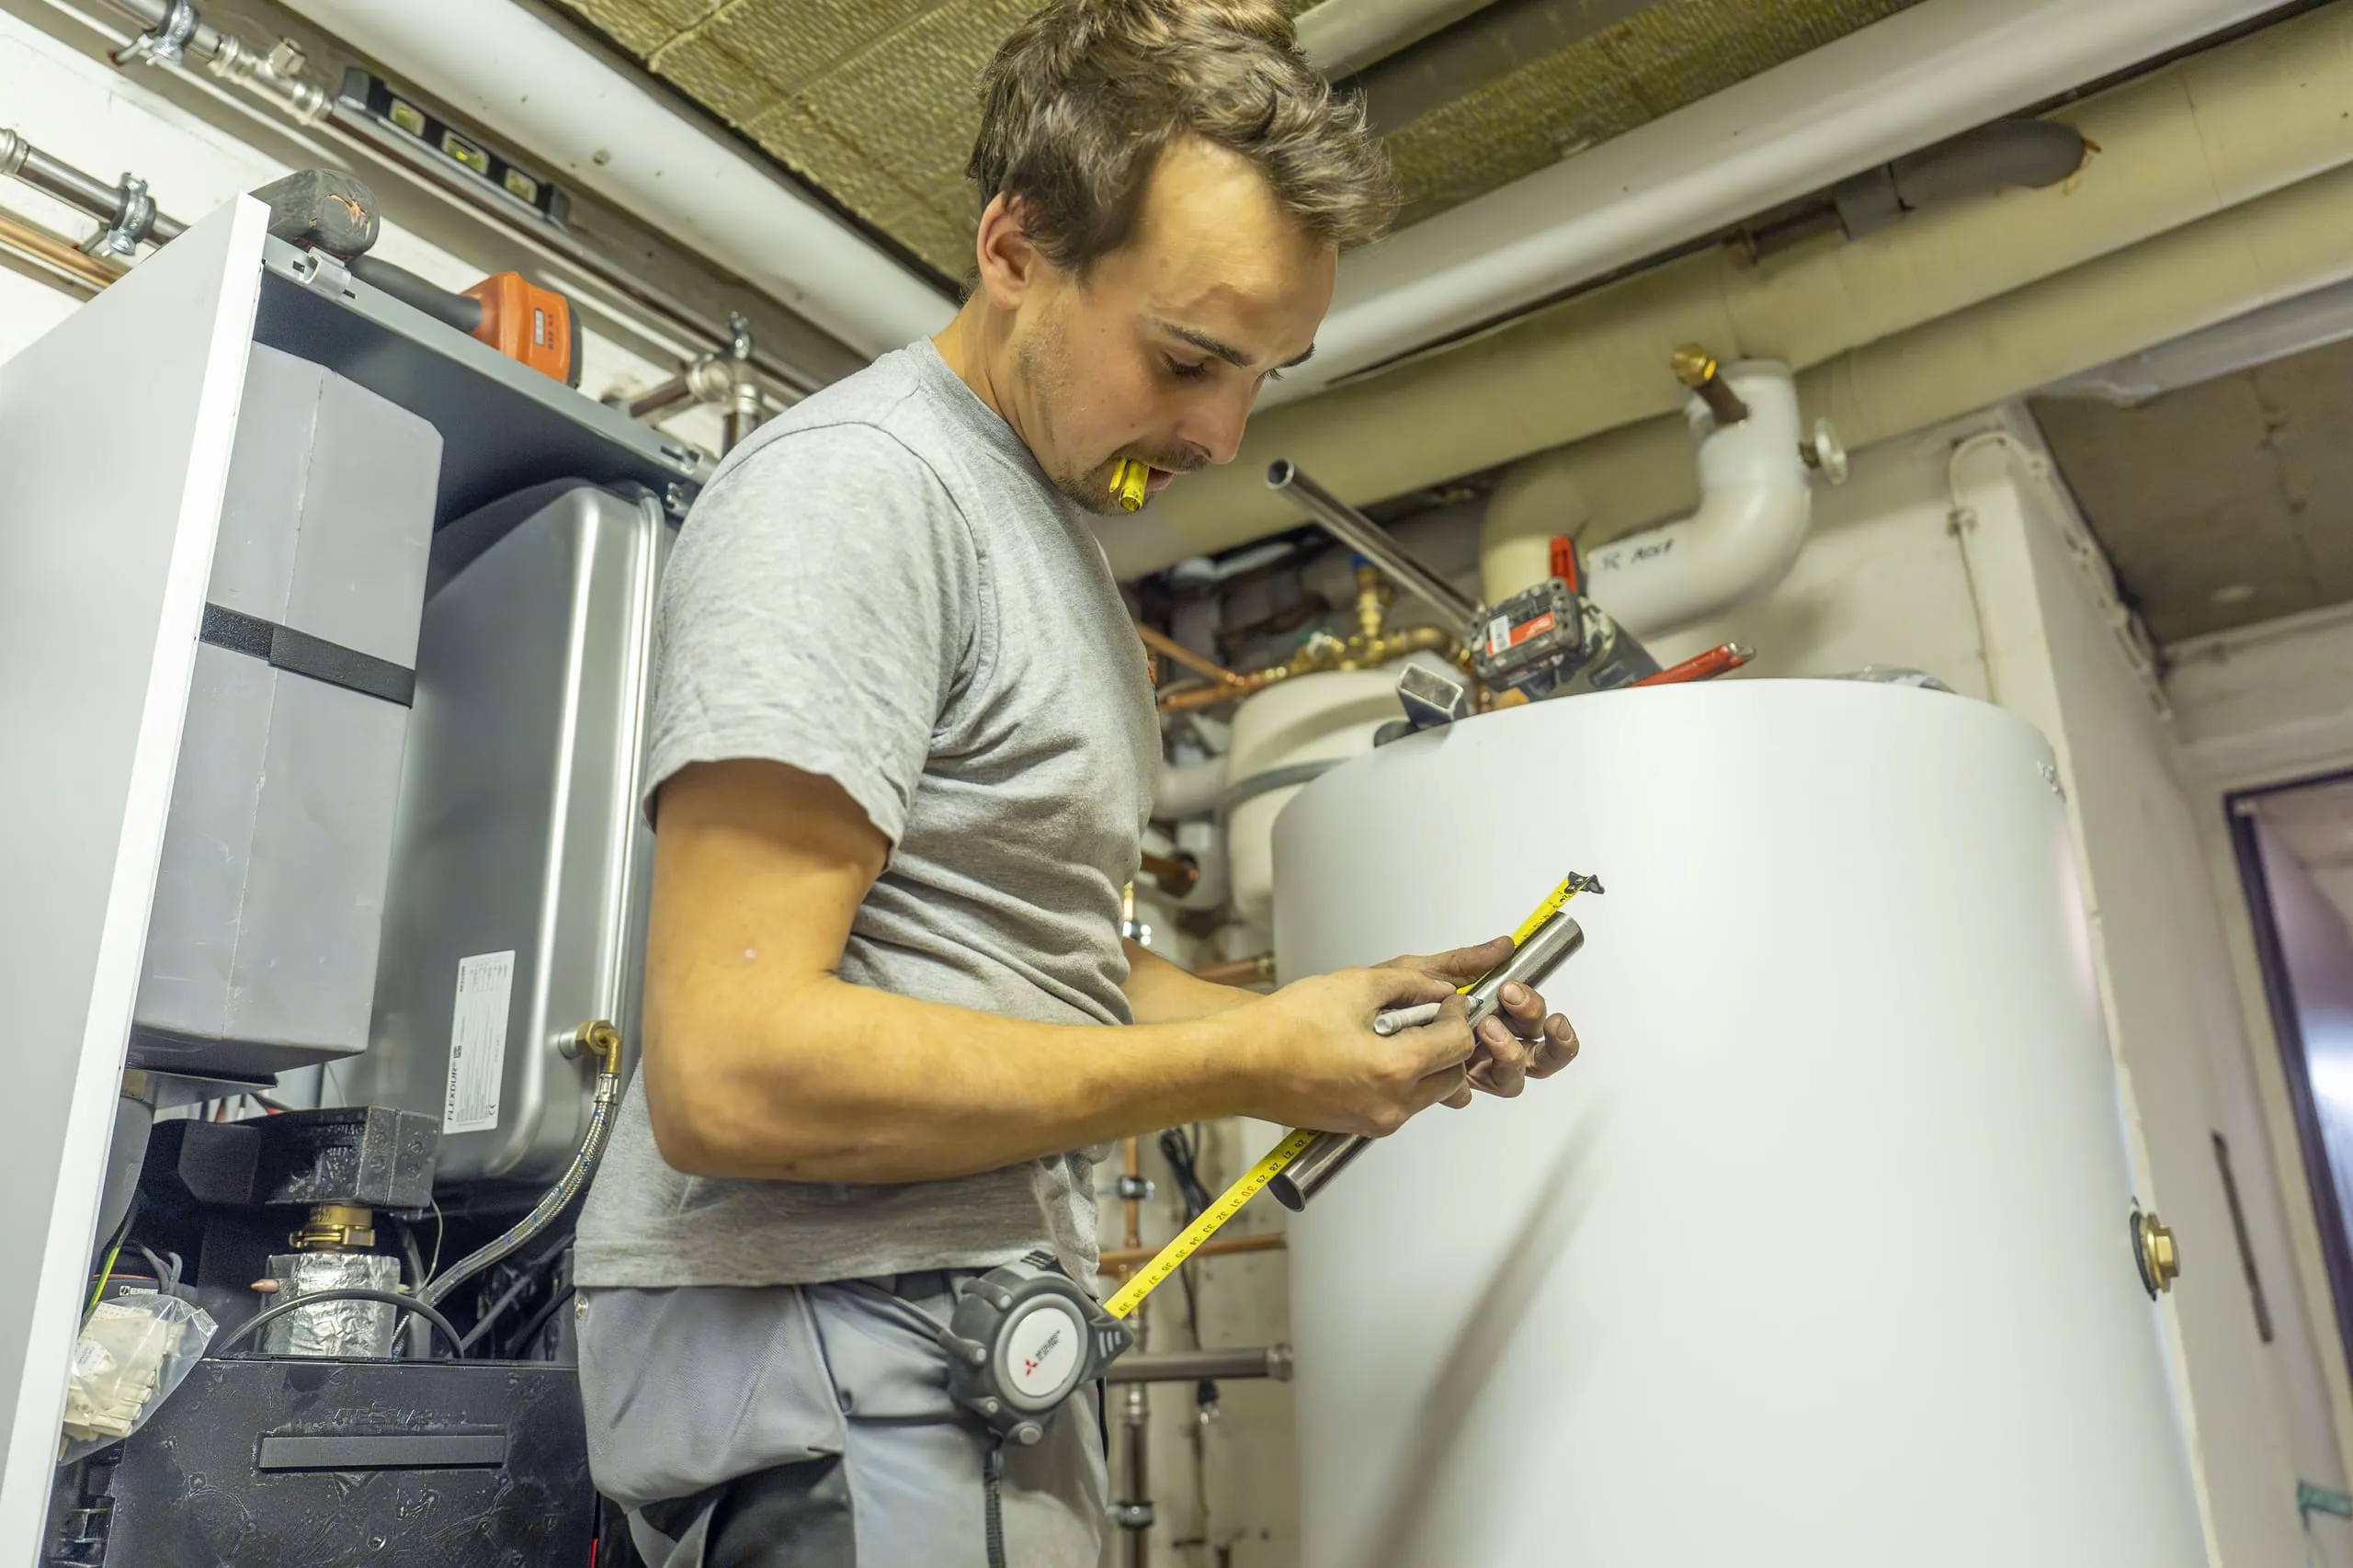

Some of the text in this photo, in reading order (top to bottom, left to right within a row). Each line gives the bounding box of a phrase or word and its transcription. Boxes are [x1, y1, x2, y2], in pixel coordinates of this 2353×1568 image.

[1118, 1139, 1307, 1312] 26 27 28 29 30 31 32 33 34 35 36 37 38 39
